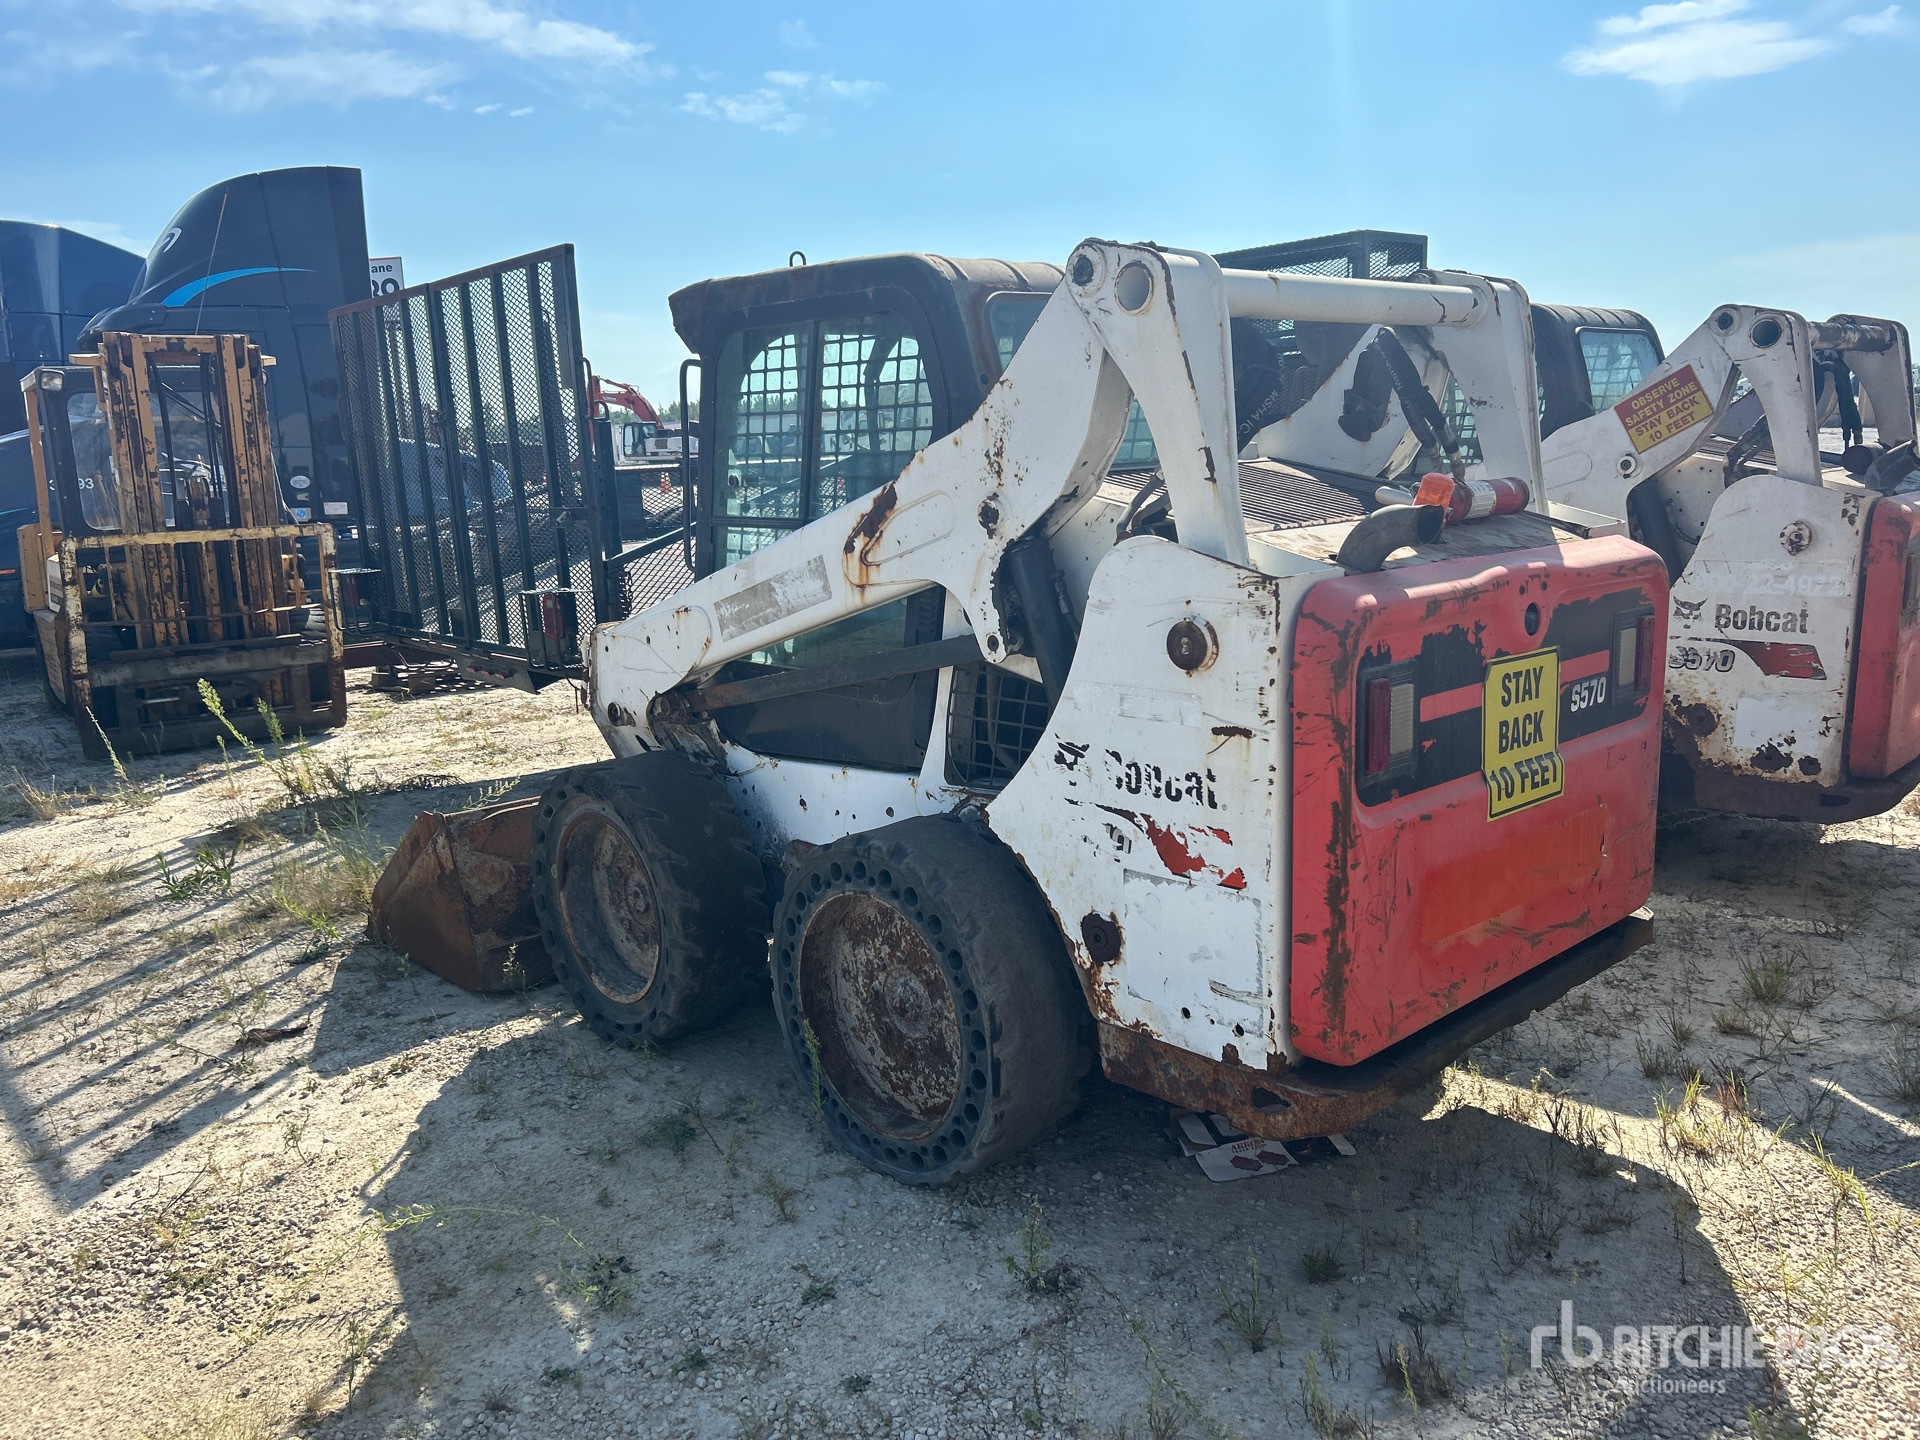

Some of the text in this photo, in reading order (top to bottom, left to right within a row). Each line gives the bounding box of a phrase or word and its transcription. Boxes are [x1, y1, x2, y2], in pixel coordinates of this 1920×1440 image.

[371, 264, 393, 273] ane
[1626, 381, 1698, 427] SAFETY ZONE
[1632, 377, 1680, 410] OBSERVE
[1635, 395, 1700, 436] STAY BACK
[1649, 411, 1696, 442] 10 FEET
[1715, 603, 1809, 634] Bobcat
[1501, 665, 1544, 708] STAY
[1570, 676, 1607, 713] S570
[1498, 710, 1544, 755] BACK
[1490, 751, 1558, 802] 10 FEET
